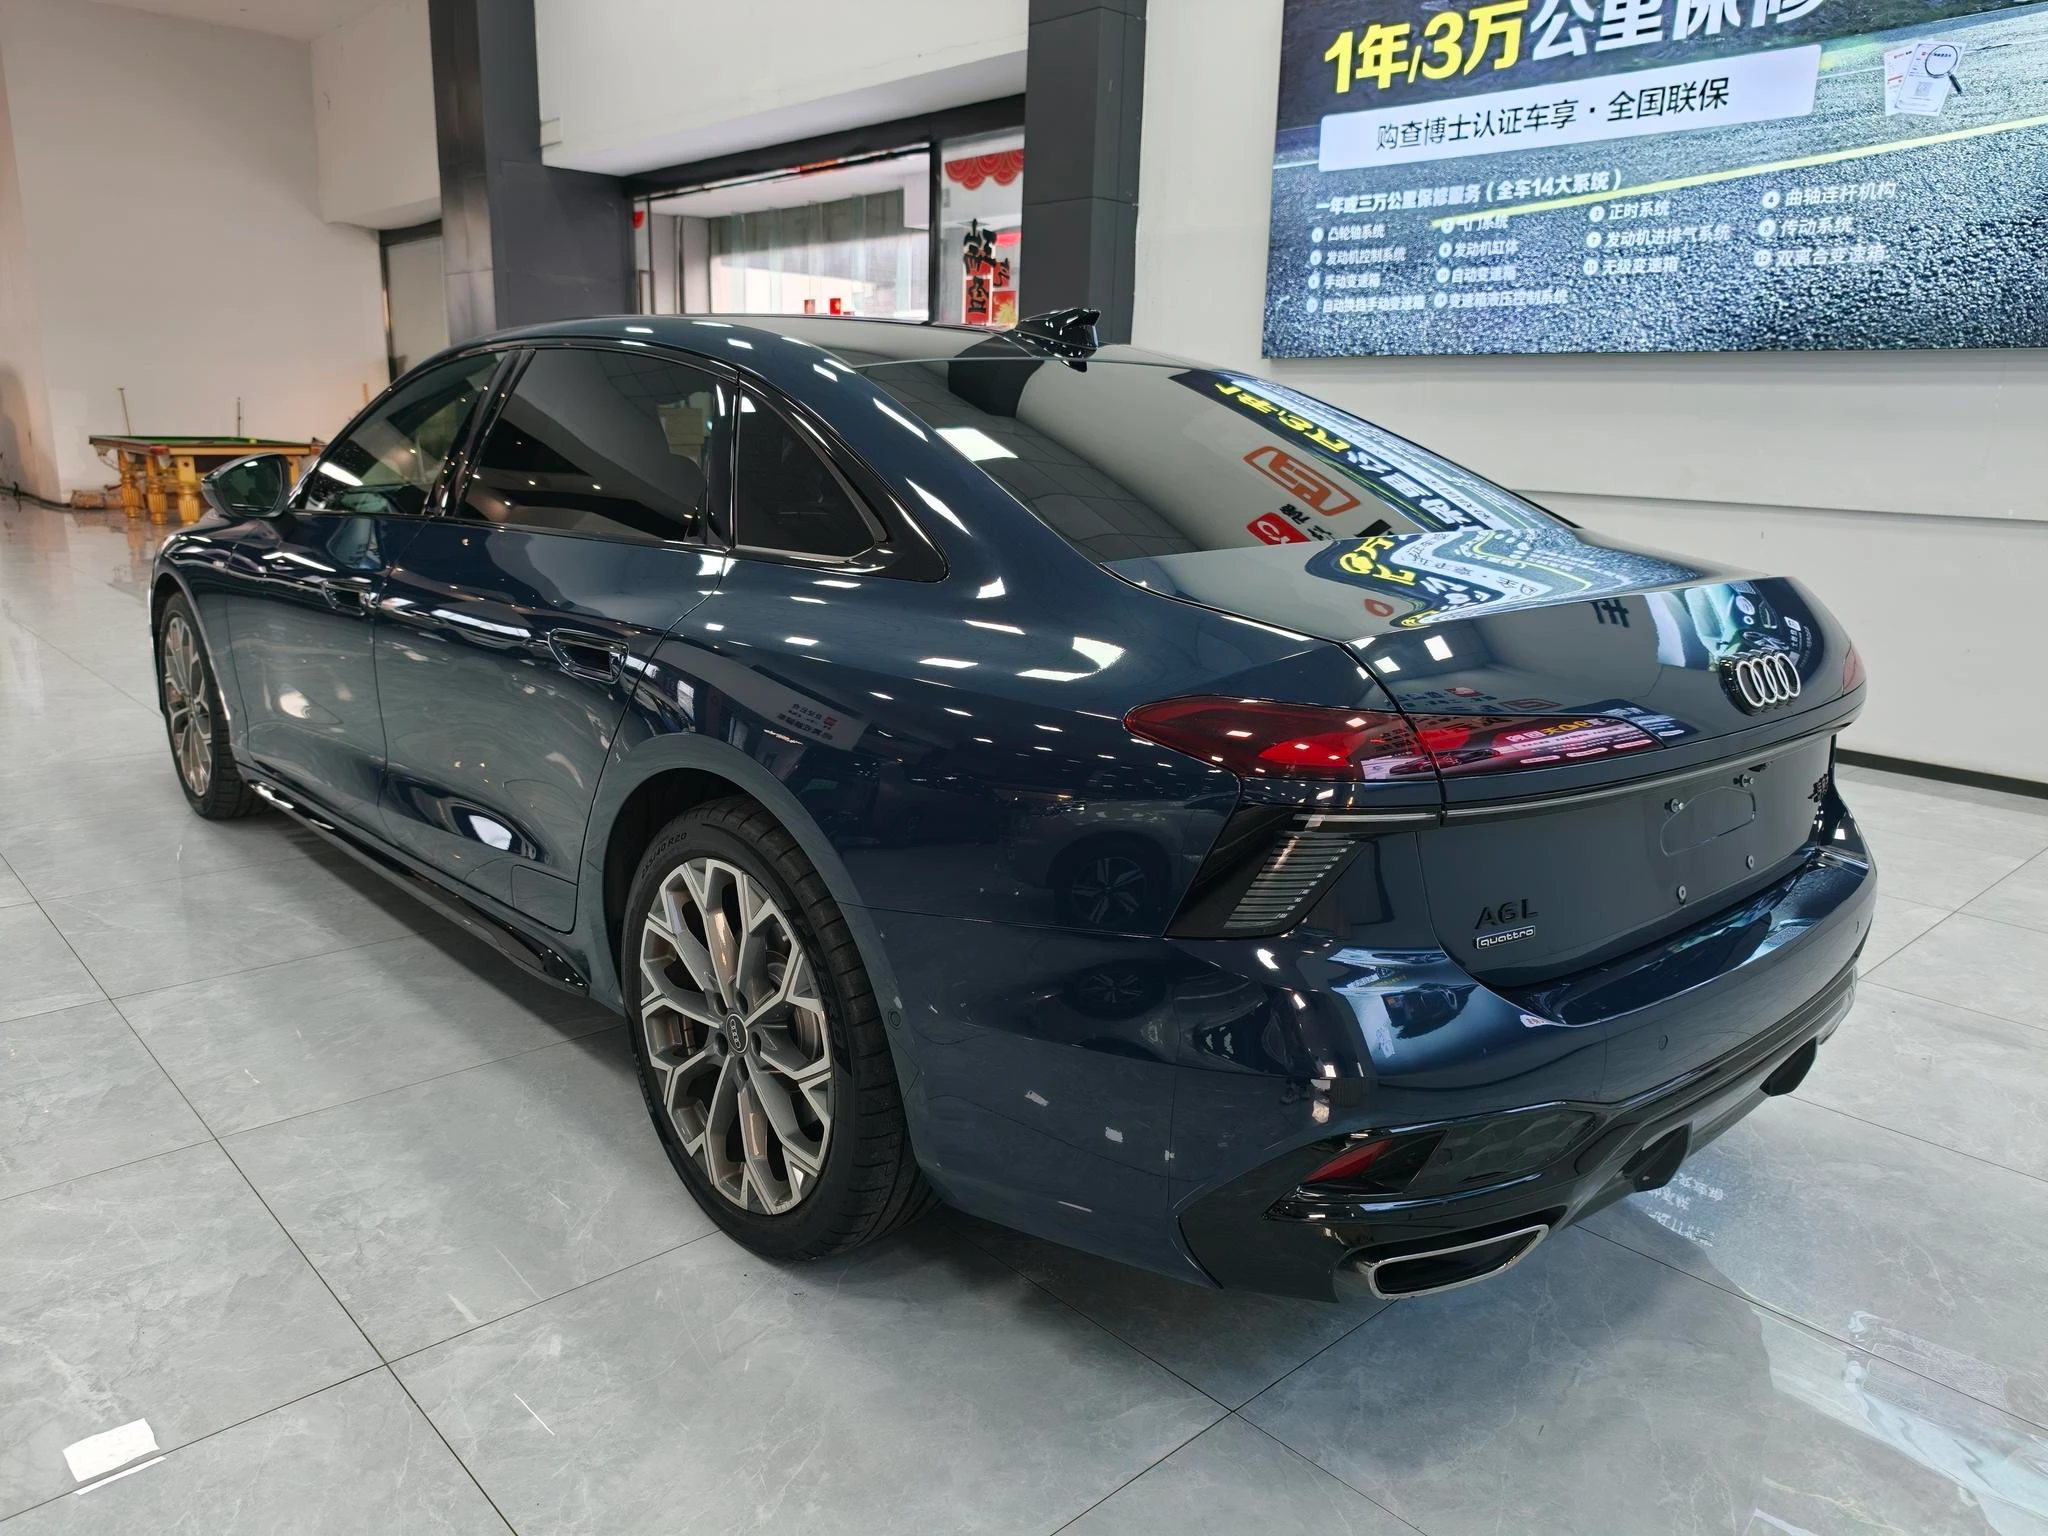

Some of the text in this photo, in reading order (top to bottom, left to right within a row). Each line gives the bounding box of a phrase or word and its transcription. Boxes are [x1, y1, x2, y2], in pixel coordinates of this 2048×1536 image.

[1609, 200, 1670, 220] 正时系统
[1781, 216, 1854, 238] 传动系统
[1475, 899, 1539, 930] A6L
[1480, 929, 1534, 947] quattro
